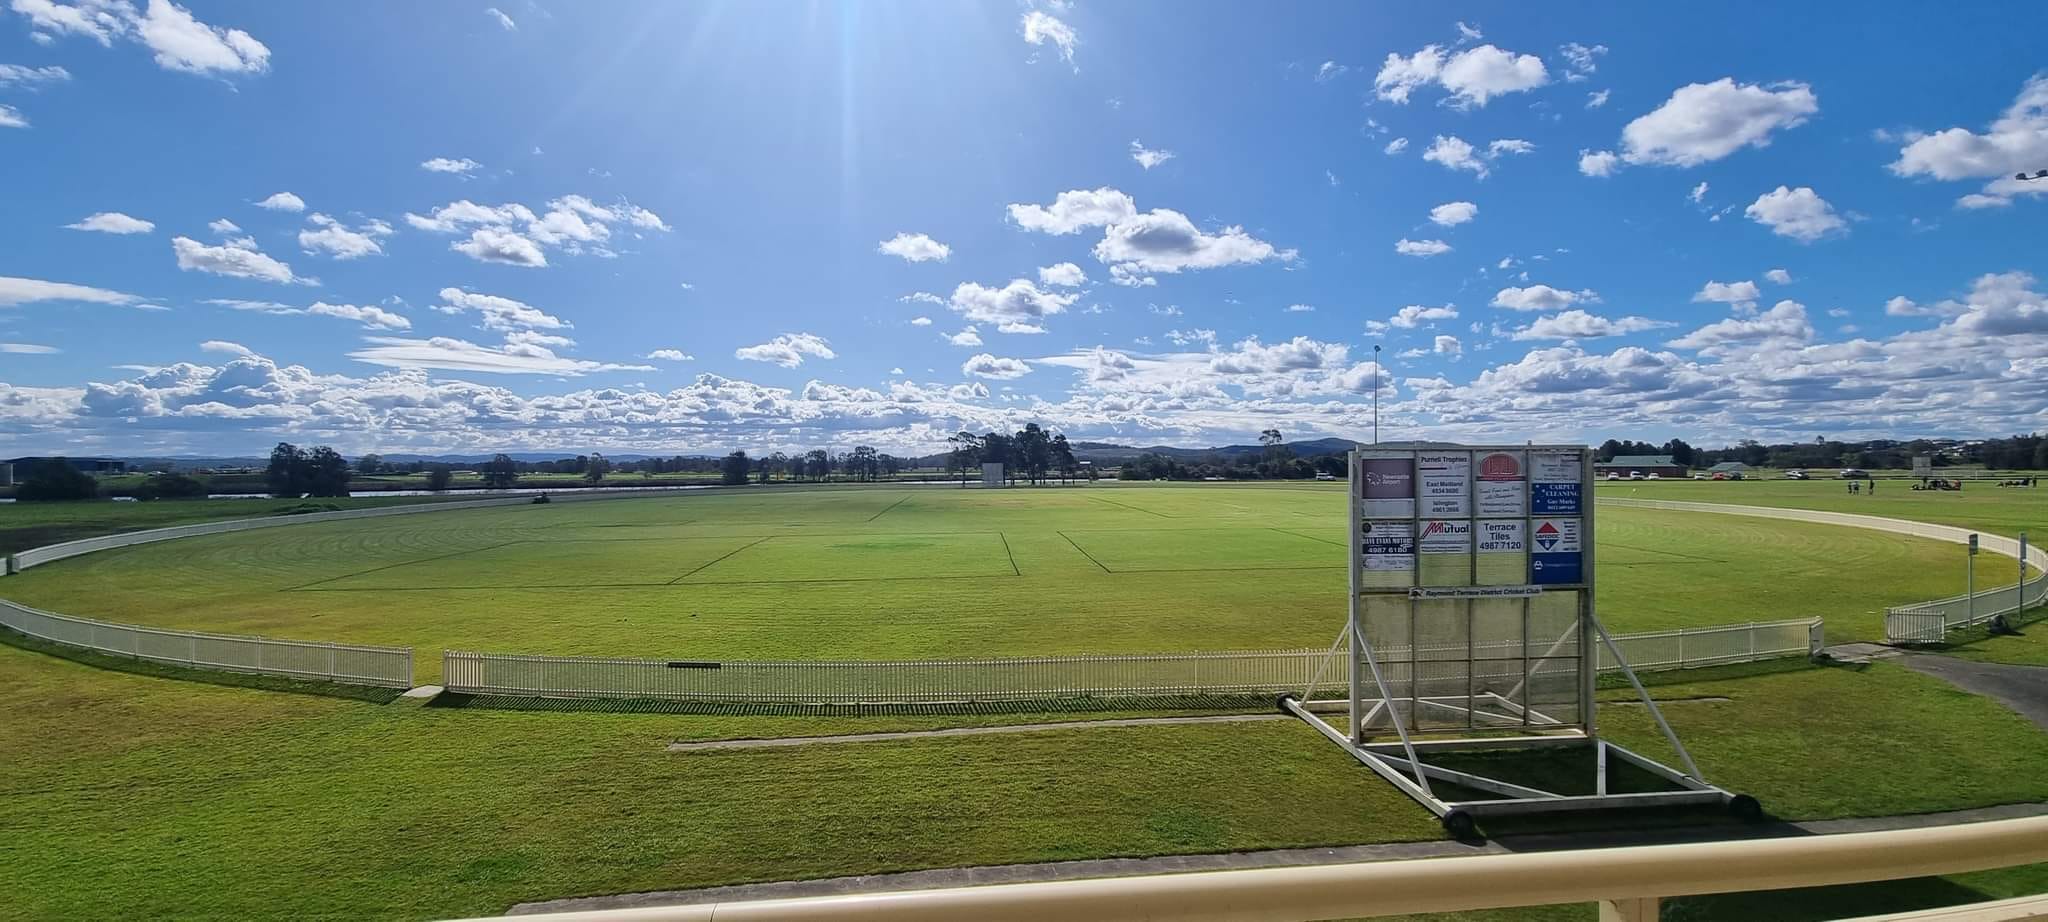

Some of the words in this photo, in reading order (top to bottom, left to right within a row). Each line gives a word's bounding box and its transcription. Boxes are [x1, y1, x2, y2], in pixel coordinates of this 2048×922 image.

[1442, 456, 1467, 464] Trophies
[1484, 523, 1516, 531] Terrace
[1490, 532, 1511, 540] Tiles
[1479, 541, 1499, 550] 4987
[1501, 541, 1521, 549] 7120
